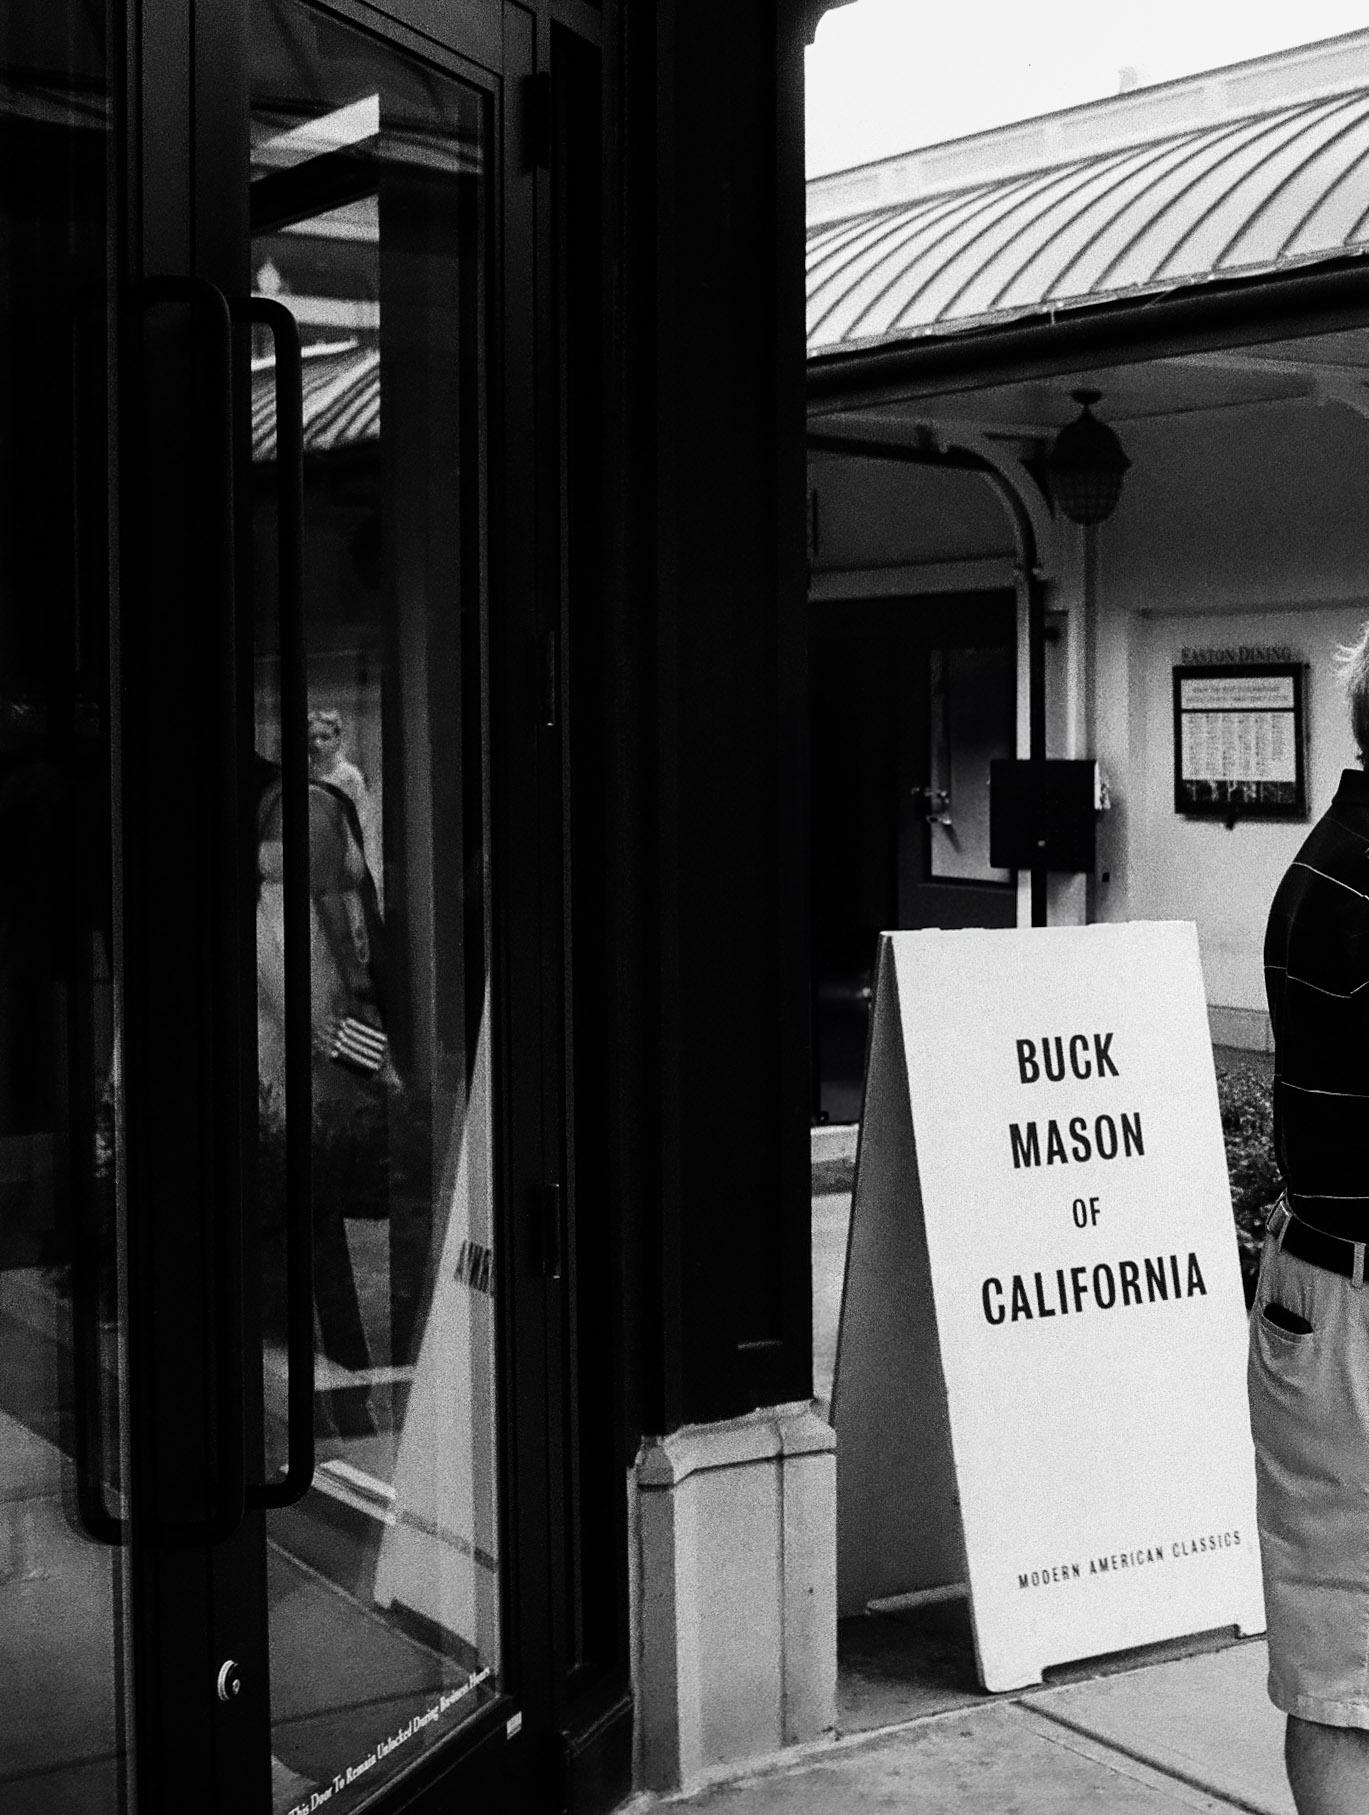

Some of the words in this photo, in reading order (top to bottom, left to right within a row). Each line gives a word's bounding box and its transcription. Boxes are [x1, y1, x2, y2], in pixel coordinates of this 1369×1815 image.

[1015, 1032, 1120, 1085] BUCK
[1008, 1112, 1145, 1169] MASON
[1072, 1196, 1101, 1229] OF
[981, 1252, 1207, 1326] CALIFORNIA
[1018, 1563, 1080, 1589] MODERN
[1089, 1546, 1164, 1575] AMERICAN
[1172, 1530, 1241, 1558] CLASSICS
[310, 1786, 333, 1812] Door
[332, 1774, 345, 1793] To
[346, 1753, 377, 1785] Remain
[377, 1720, 412, 1759] Unlocked
[413, 1705, 439, 1733] During
[440, 1683, 469, 1712] Business
[469, 1666, 491, 1689] Hours
